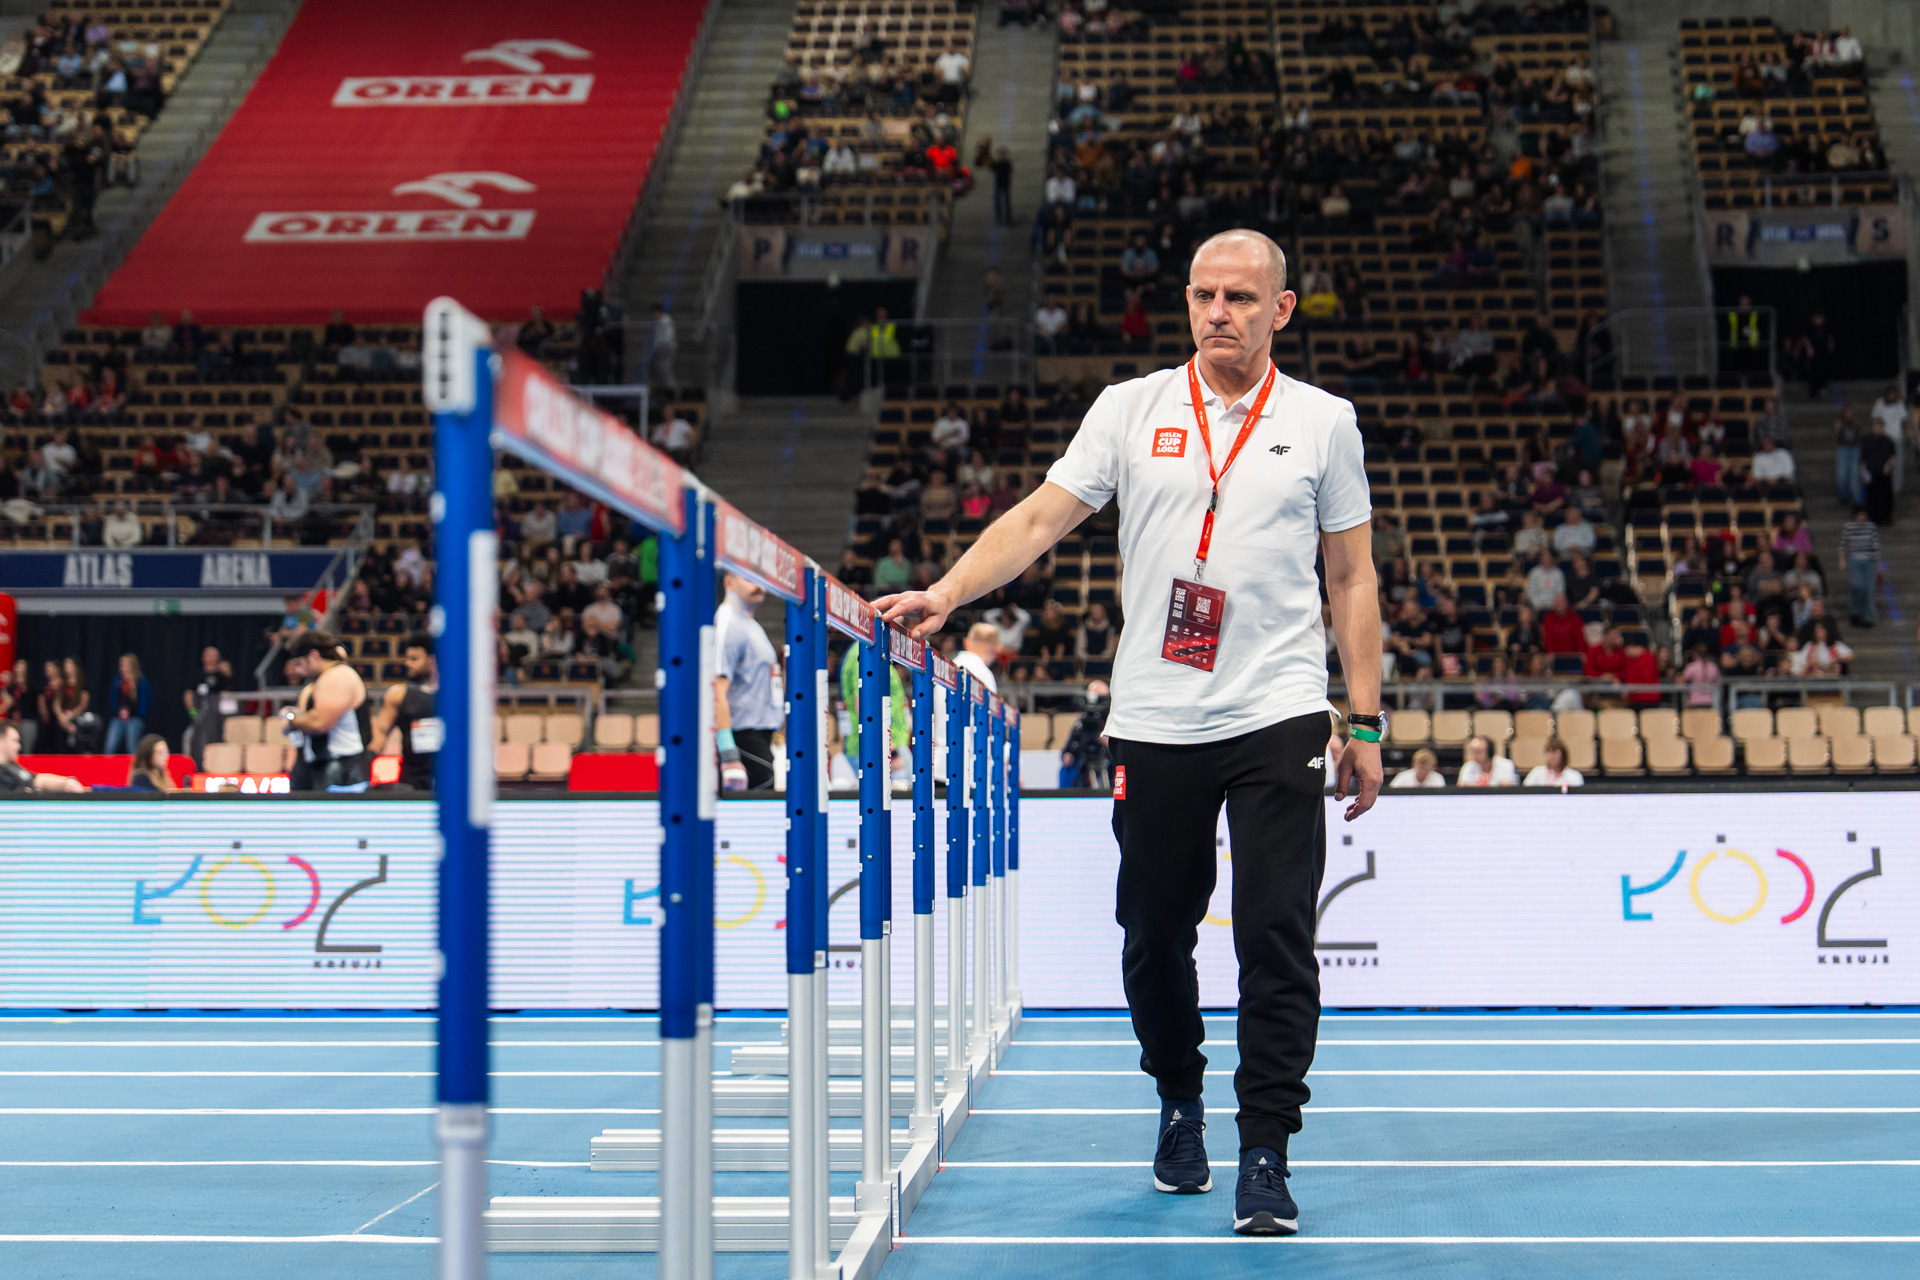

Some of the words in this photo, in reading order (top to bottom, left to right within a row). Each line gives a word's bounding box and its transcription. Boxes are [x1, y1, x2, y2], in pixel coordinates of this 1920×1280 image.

[353, 80, 574, 98] ORLEN
[267, 211, 513, 235] ORLEN
[1157, 437, 1181, 446] CUP
[1156, 444, 1179, 453] ŁÓDŹ
[1269, 444, 1291, 455] 4F
[63, 553, 133, 587] ATLAS
[200, 553, 271, 587] ARENA
[1307, 756, 1325, 769] 4F
[1323, 957, 1378, 966] REUJE
